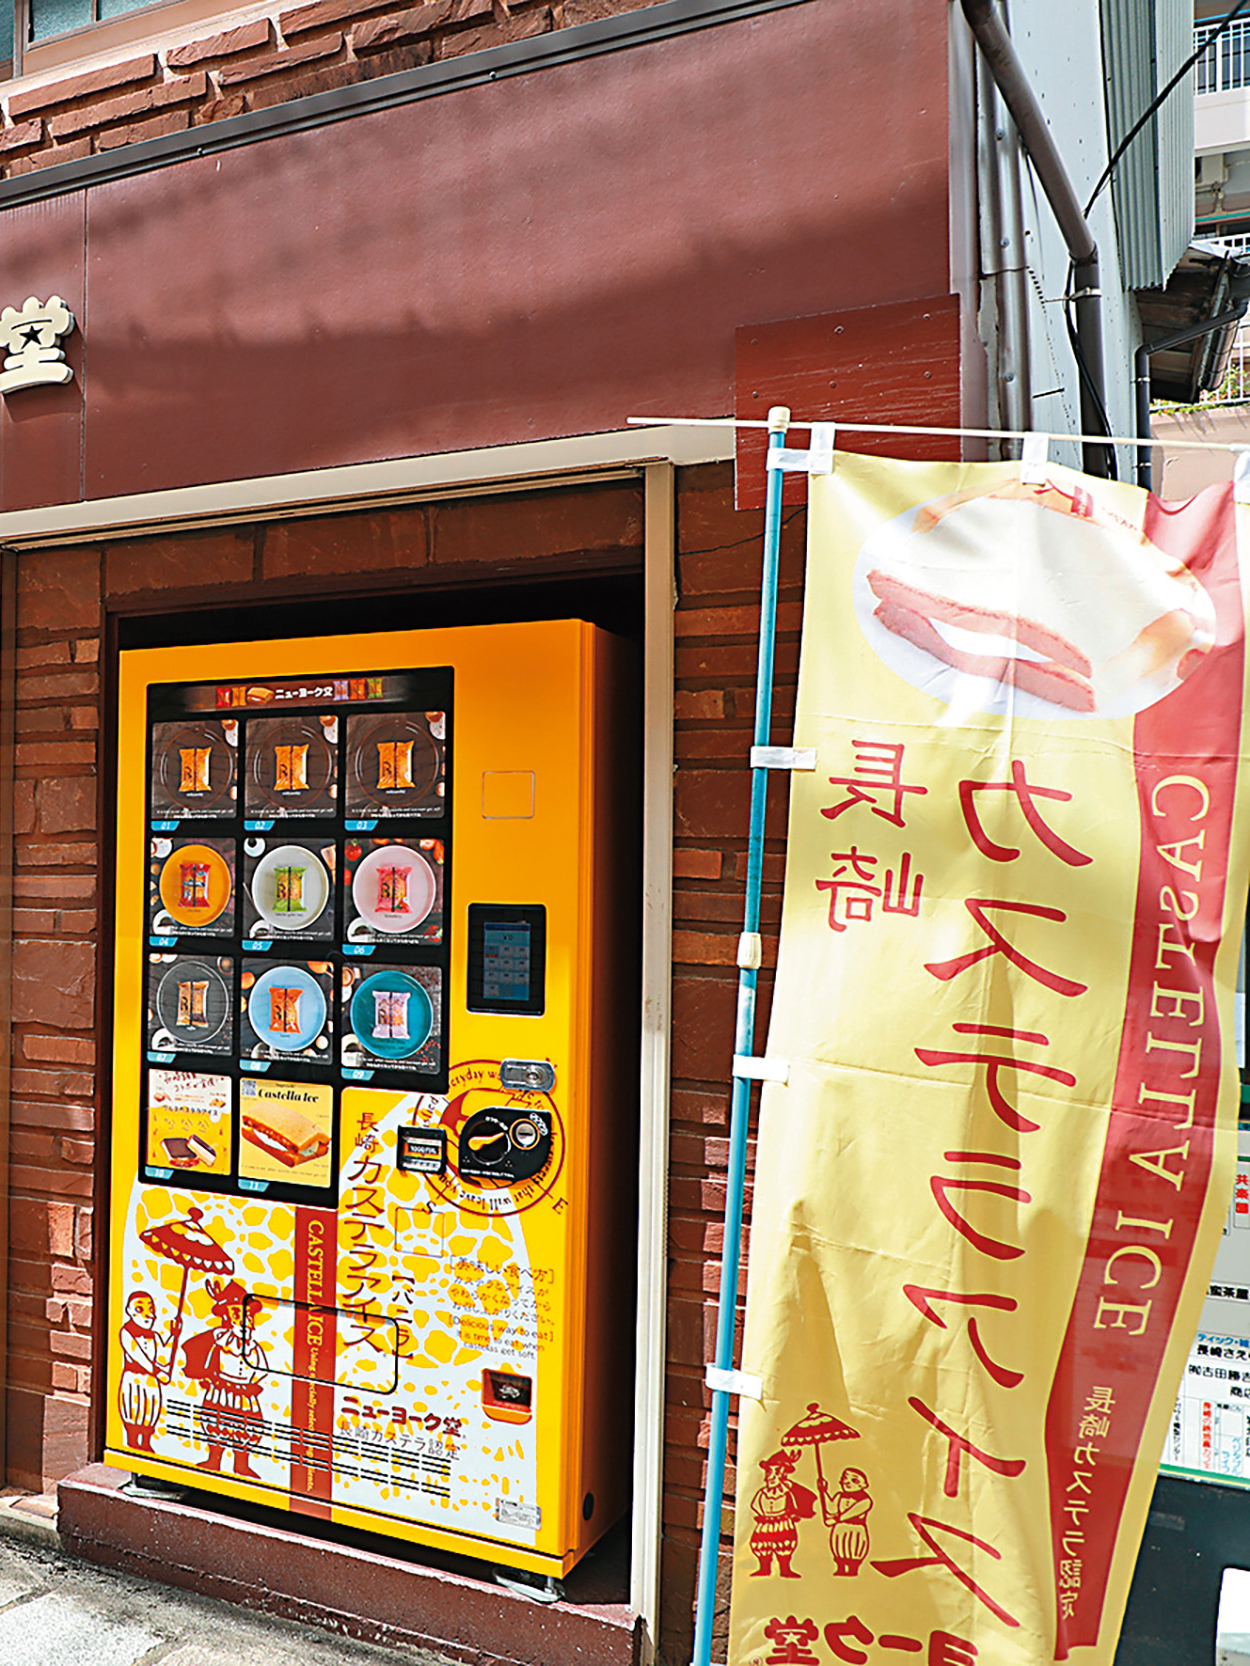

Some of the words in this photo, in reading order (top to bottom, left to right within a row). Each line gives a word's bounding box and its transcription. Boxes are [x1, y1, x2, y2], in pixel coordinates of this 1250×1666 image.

[258, 1087, 302, 1103] Castella
[303, 1092, 320, 1104] Ice
[342, 1112, 385, 1355] 長崎カステラアイス
[307, 1219, 325, 1311] CASTELLA
[307, 1313, 324, 1347] ICE
[341, 1395, 463, 1437] ニューヨーク堂
[339, 1421, 461, 1460] 長崎カステラ認定
